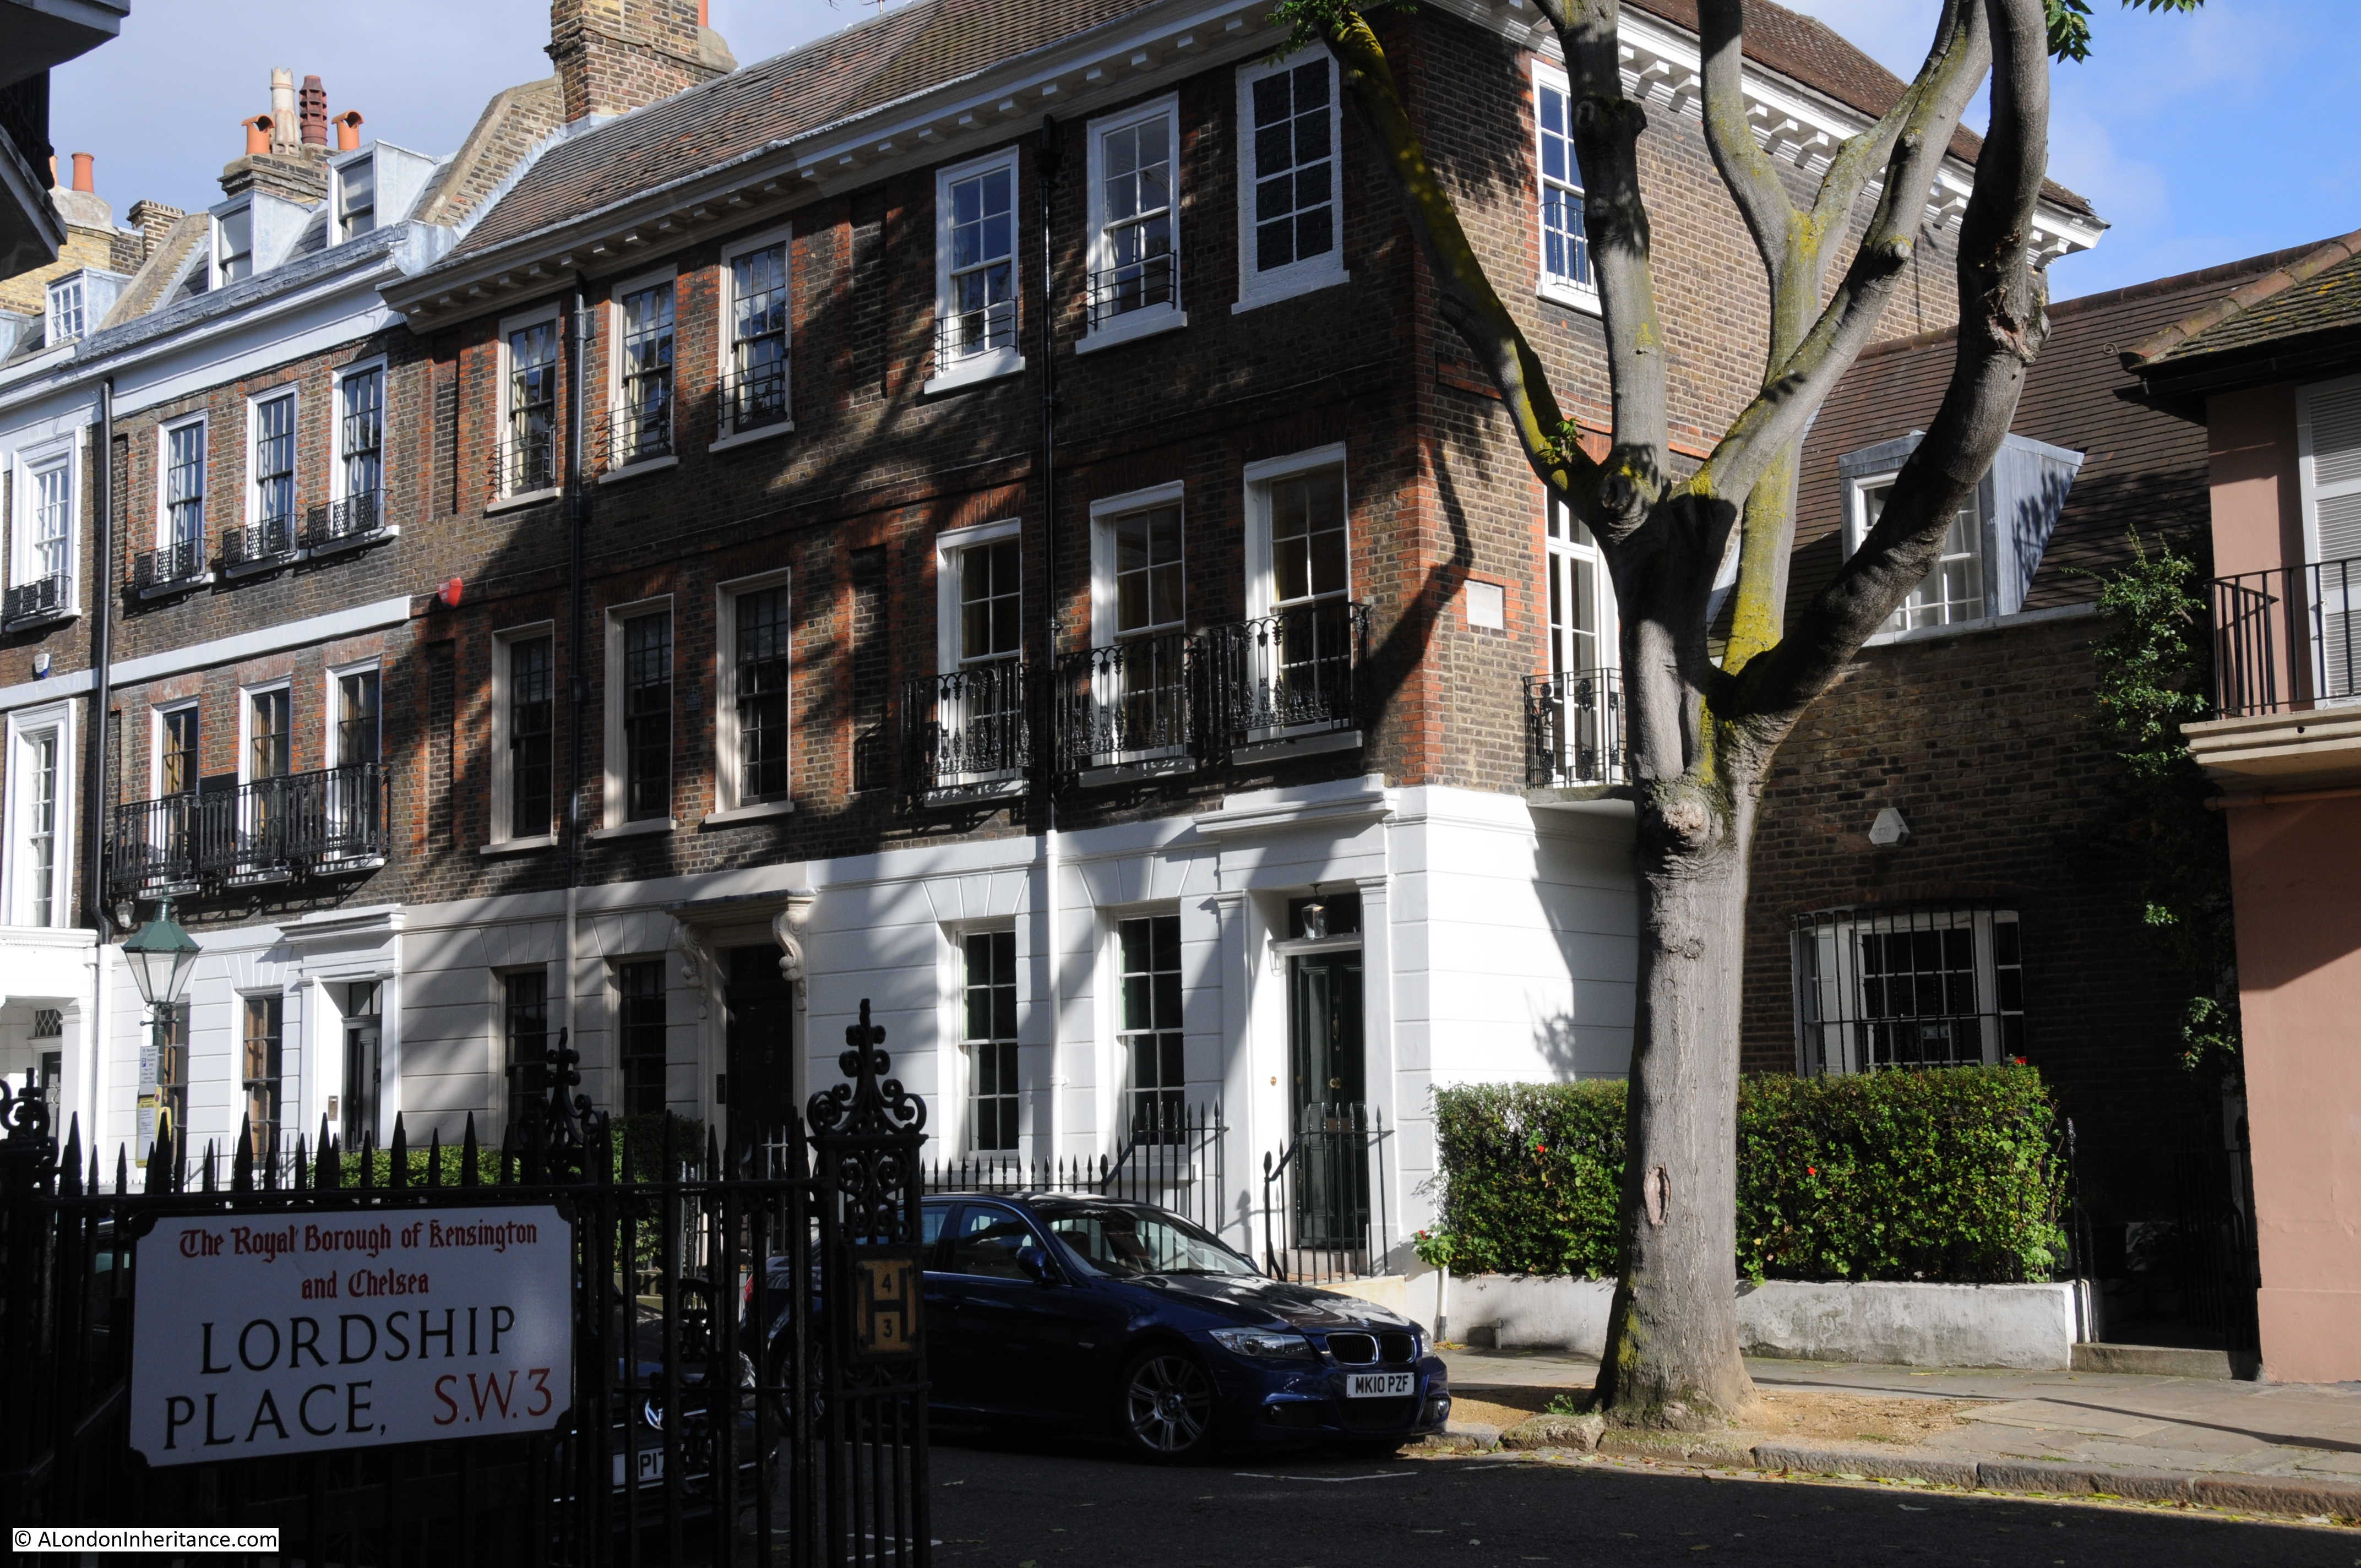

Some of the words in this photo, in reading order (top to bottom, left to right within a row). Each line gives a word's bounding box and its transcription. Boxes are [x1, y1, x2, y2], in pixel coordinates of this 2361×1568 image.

[179, 1228, 224, 1258] The
[230, 1224, 296, 1264] Royal
[304, 1223, 391, 1259] Borough
[401, 1221, 423, 1248] of
[429, 1218, 537, 1254] Kensington
[302, 1270, 338, 1300] and
[348, 1267, 429, 1298] Chelsea
[882, 1273, 892, 1293] 4
[863, 1267, 909, 1345] H
[200, 1305, 515, 1375] LORDSHIP
[883, 1318, 893, 1338] 3
[1355, 1376, 1385, 1393] MK10
[1388, 1375, 1409, 1392] PZF
[163, 1380, 387, 1450] PLACE,
[433, 1367, 552, 1425] S.W.3
